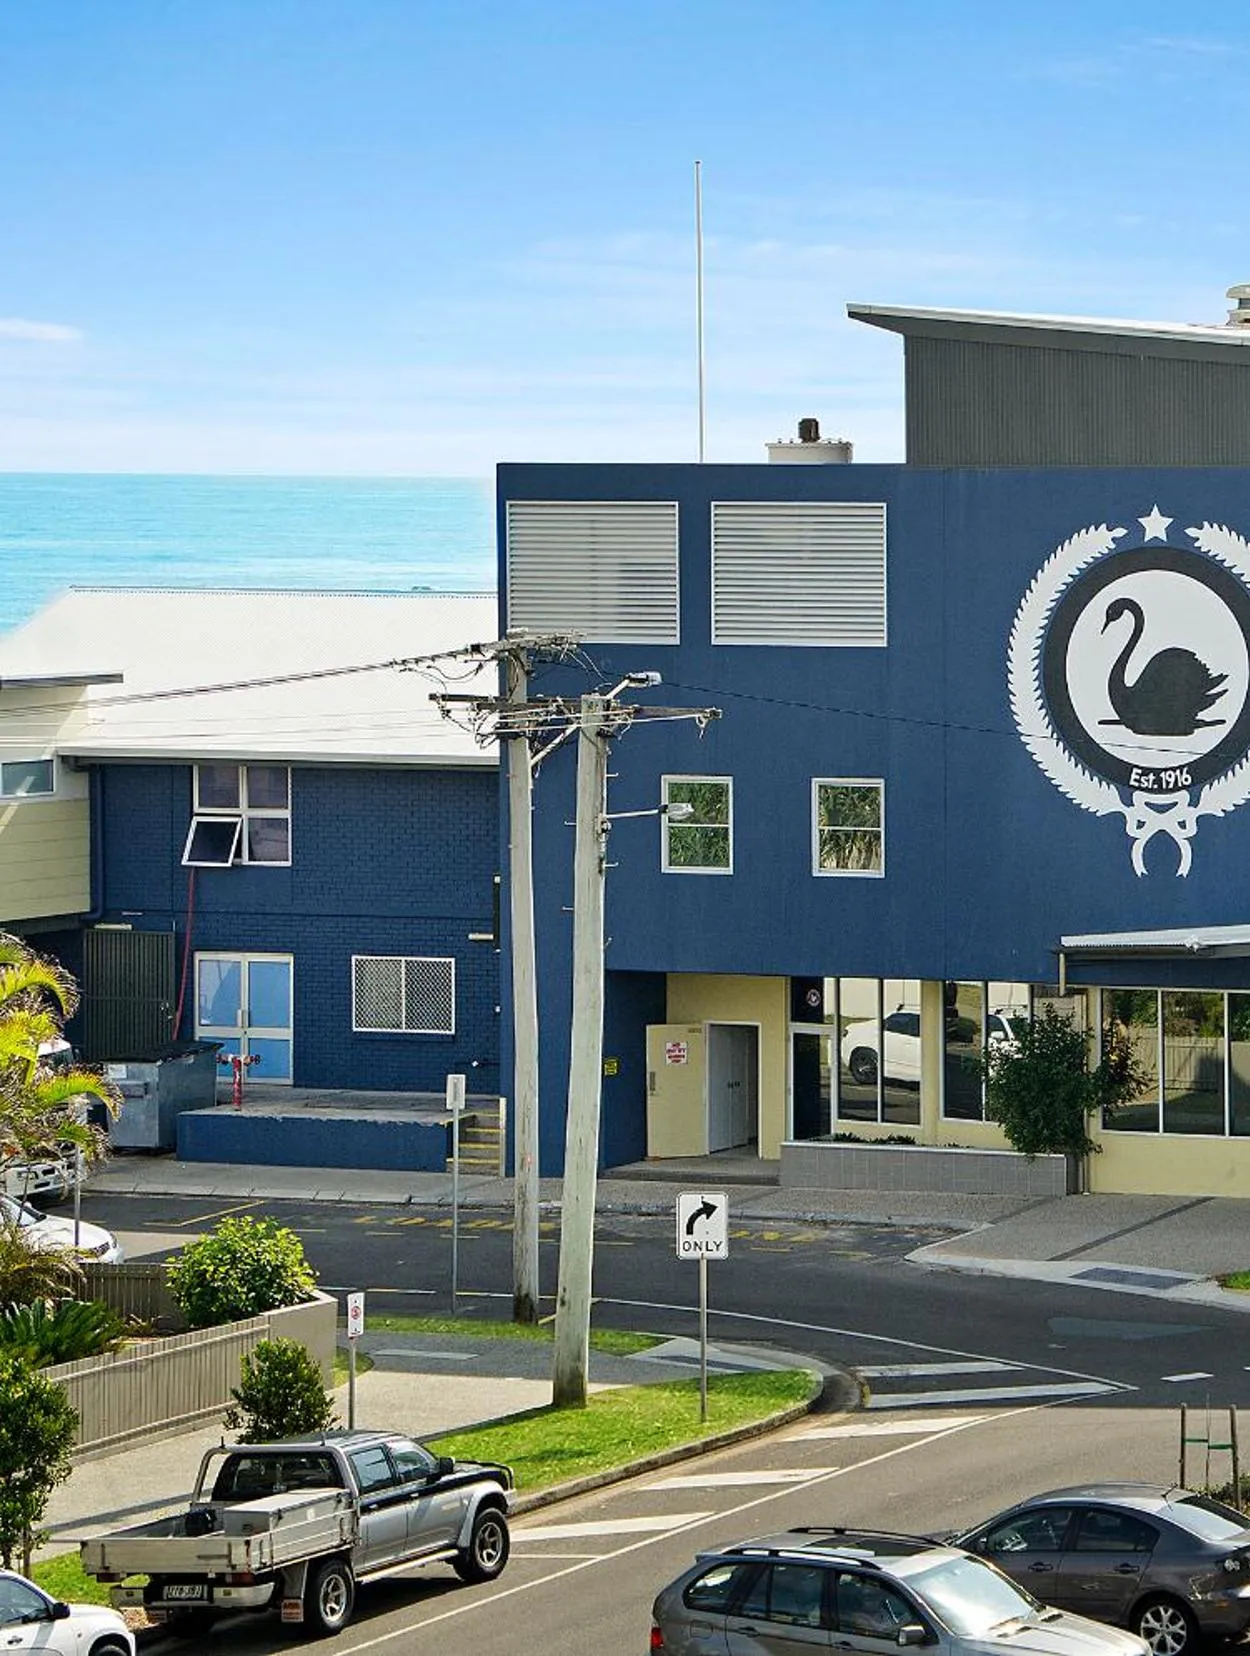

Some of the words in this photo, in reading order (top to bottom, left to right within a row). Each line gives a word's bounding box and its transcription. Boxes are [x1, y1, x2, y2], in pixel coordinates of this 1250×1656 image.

[1129, 767, 1158, 789] Est.
[1160, 767, 1192, 789] 1916
[682, 1240, 723, 1252] ONLY
